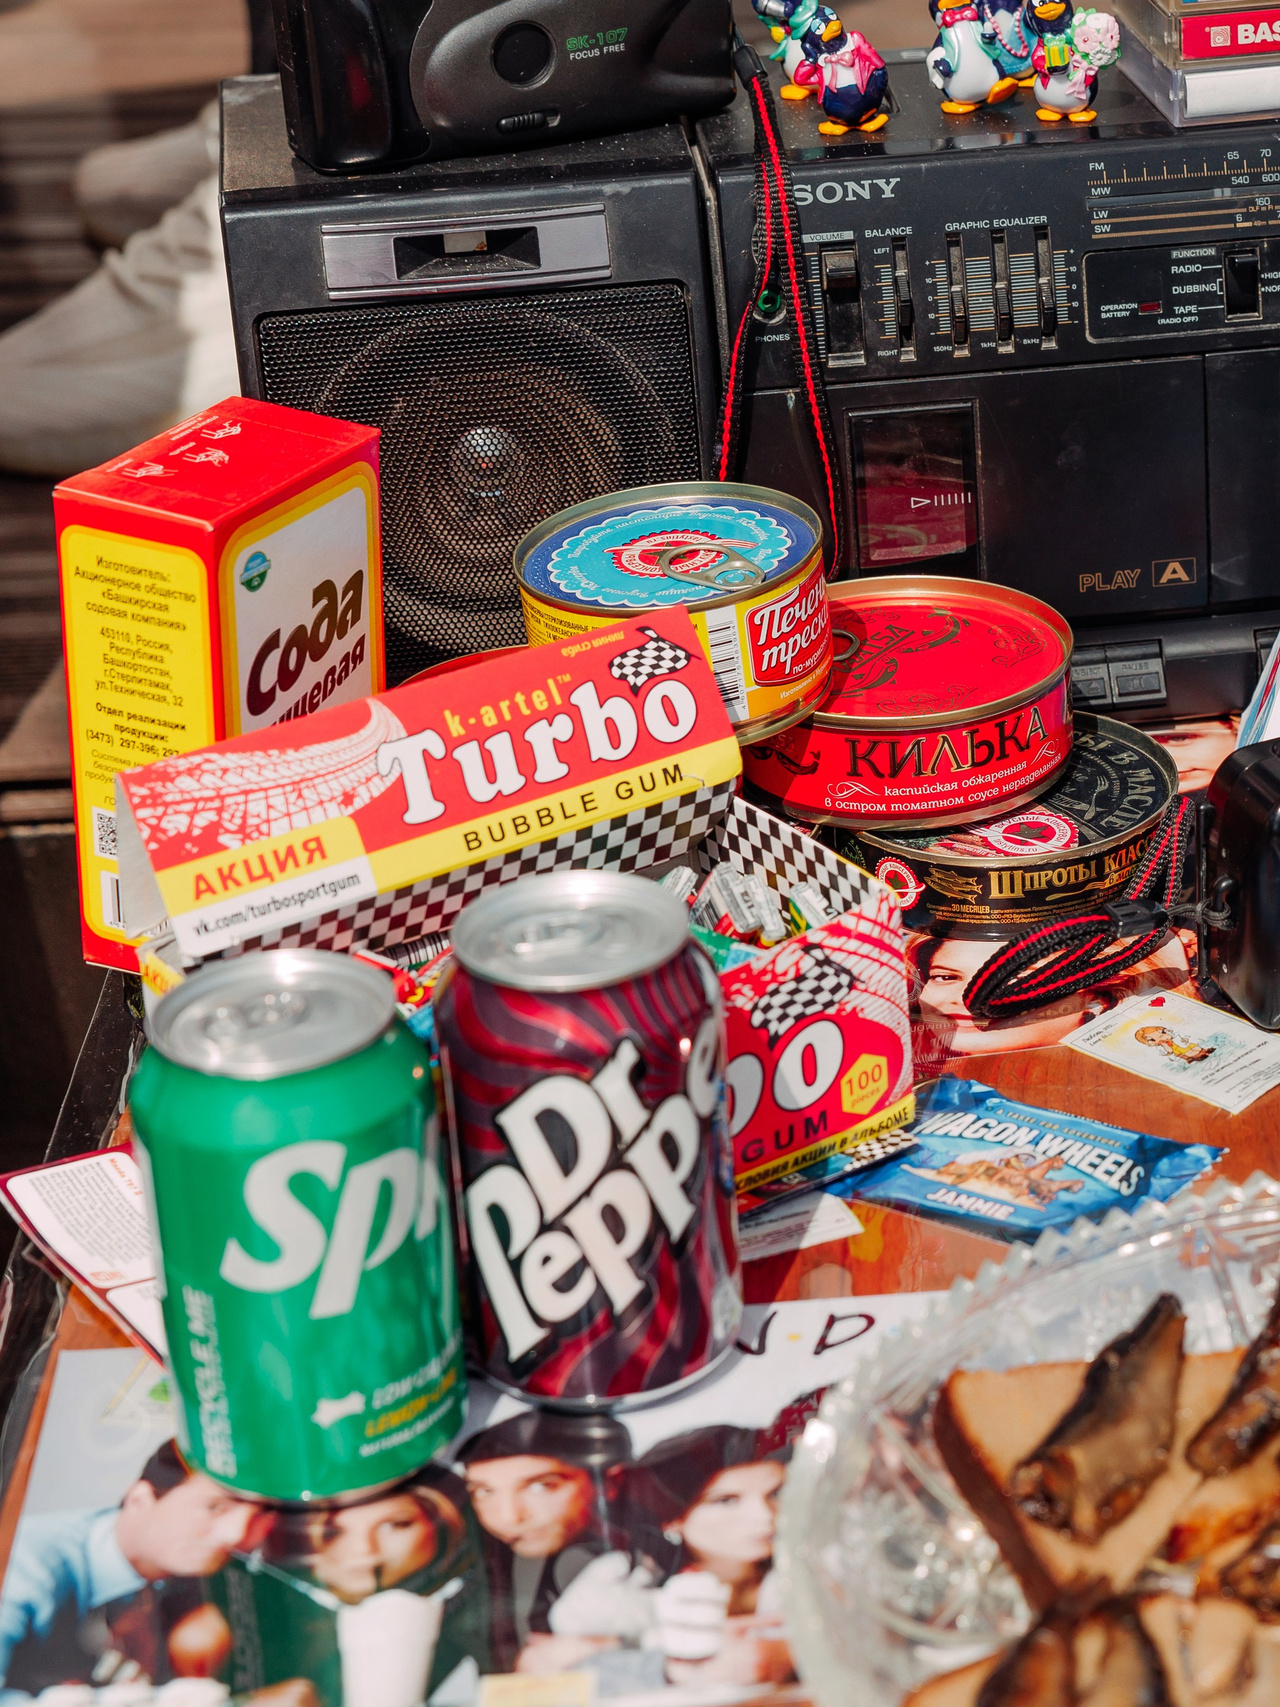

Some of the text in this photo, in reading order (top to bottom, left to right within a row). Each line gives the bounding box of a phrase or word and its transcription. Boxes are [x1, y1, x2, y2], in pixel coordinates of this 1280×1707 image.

[566, 27, 628, 51] SK-107
[569, 43, 626, 61] FOCUS FREE
[1089, 162, 1105, 171] FM
[793, 178, 900, 206] SONY
[1091, 187, 1111, 196] MW
[1231, 175, 1250, 185] 540
[1261, 172, 1280, 182] 600
[945, 215, 1047, 232] GRAPHIC EQUALIZER
[1093, 210, 1109, 219] LW
[809, 232, 845, 242] VOLUME
[864, 226, 912, 239] BALANCE
[1094, 224, 1111, 233] SW
[873, 247, 890, 255] LEFT
[1173, 248, 1215, 258] FUNCTION
[1171, 263, 1202, 275] RADIO
[1172, 283, 1217, 295] DUBBING
[1100, 302, 1138, 312] OPERATION
[1101, 310, 1131, 319] BATTERY
[1173, 305, 1198, 315] TAPE
[1157, 315, 1199, 326] (RADIO OFF)
[755, 333, 790, 343] PHONES
[933, 337, 1040, 353] 150Hz 1kHz 8kHz
[877, 348, 898, 357] RIGHT
[95, 554, 172, 582] Изготовитель:
[1079, 561, 1190, 593] PLAY A
[74, 566, 196, 603] Акционерное общество
[86, 601, 129, 619] содовая
[753, 580, 826, 646] Печен
[109, 641, 165, 664] Республика
[135, 634, 174, 655] Россия,
[246, 568, 365, 717] Сода
[172, 695, 184, 707] 32
[95, 702, 186, 732] Отдел реализации
[85, 728, 114, 748] (3473)
[114, 723, 169, 742] продукции:
[843, 707, 1049, 780] КИЛЬКА
[375, 677, 699, 827] Turbo
[824, 752, 1063, 813] в остром томатном соусе неразделанная
[883, 759, 1028, 798] каспийская обжаренная
[463, 763, 684, 854] BUBBLE GUM
[193, 835, 328, 901] АКЦИЯ
[988, 860, 1098, 900] Шпроты
[951, 903, 960, 912] 30
[960, 904, 990, 914] МЕСЯЦЕВ
[846, 1062, 883, 1097] 100
[496, 1036, 651, 1225] Dr
[741, 1110, 828, 1164] GUM
[734, 1106, 909, 1190] СЛОВИЯ АКЦИИ В АЛЬБОМЕ
[913, 1111, 1145, 1196] WAGON WHEELS
[465, 1015, 719, 1364] Peppe
[926, 1186, 1015, 1220] JAMMIE
